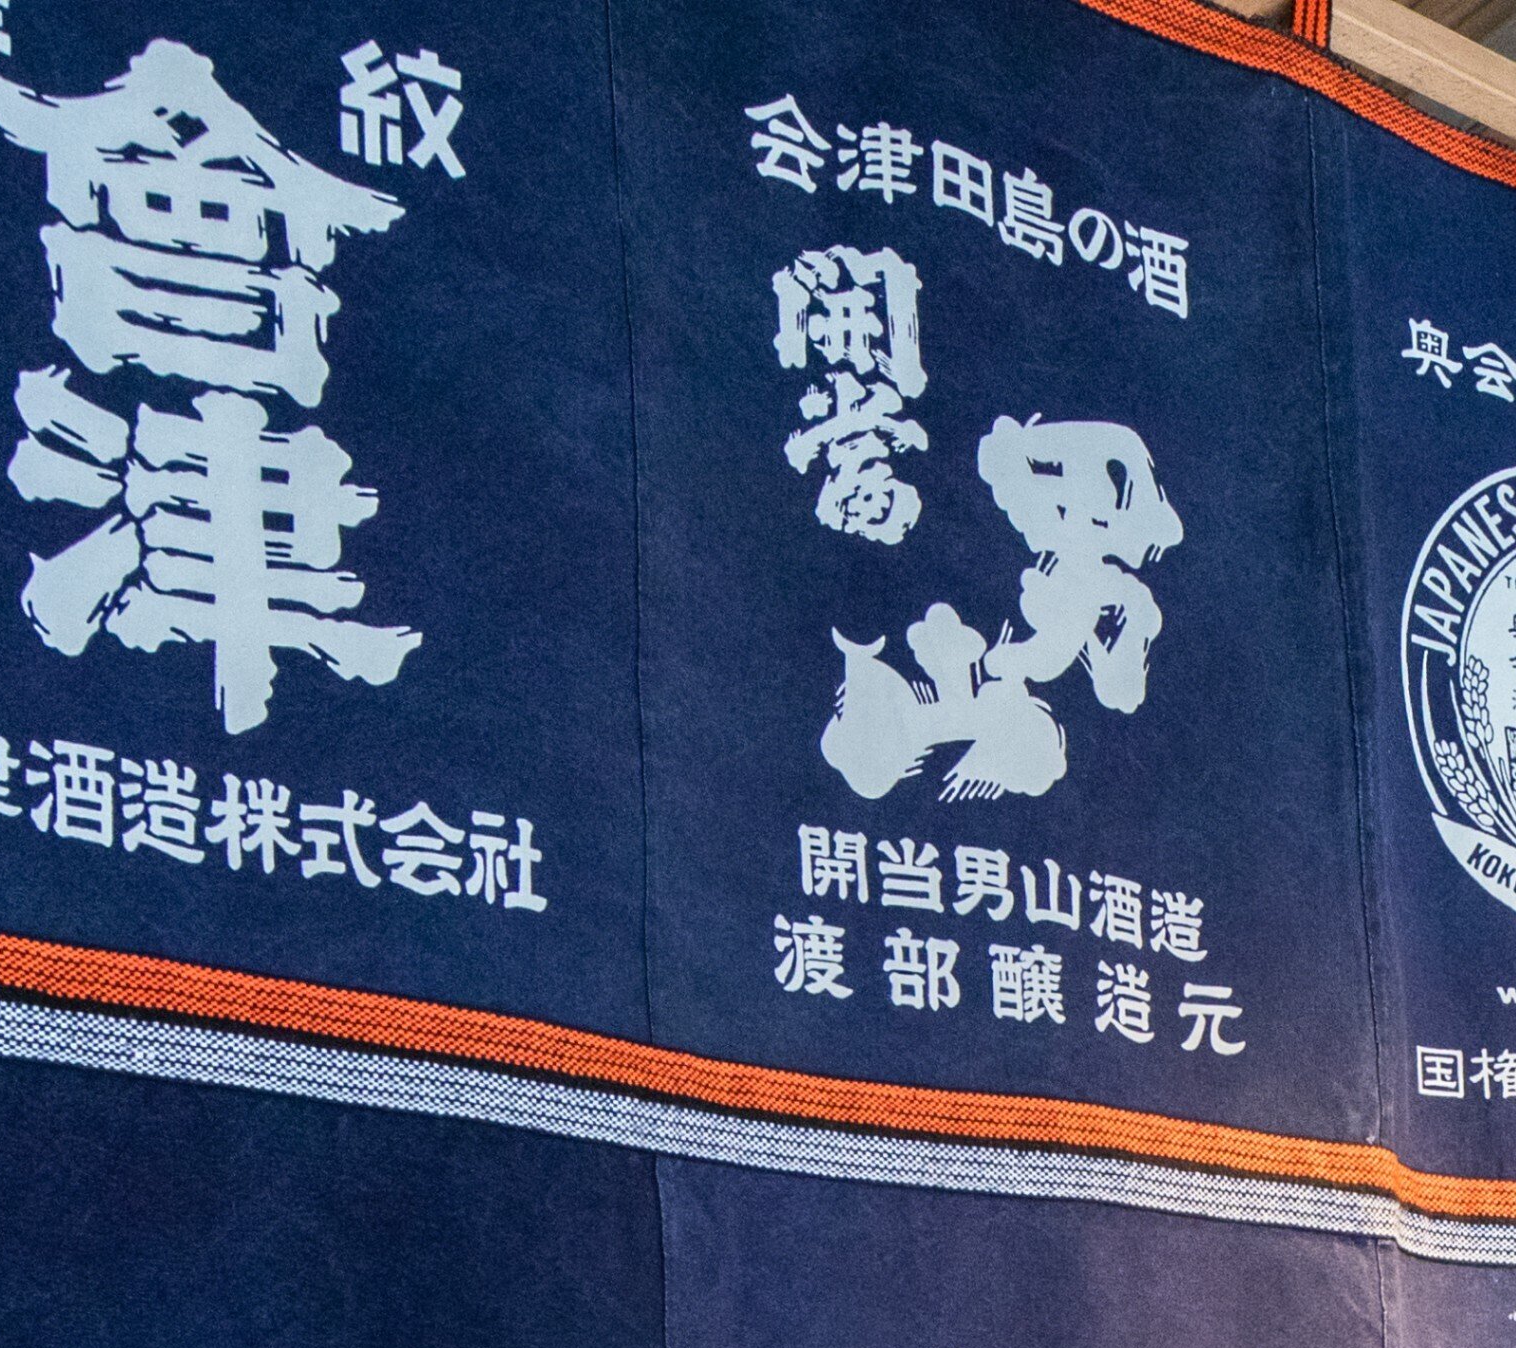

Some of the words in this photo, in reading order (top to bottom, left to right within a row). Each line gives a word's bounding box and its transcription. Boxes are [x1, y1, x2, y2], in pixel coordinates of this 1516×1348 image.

[340, 39, 466, 179] 紋
[744, 93, 1190, 319] 会津田島の酒
[798, 823, 1208, 964] 開当男山酒造
